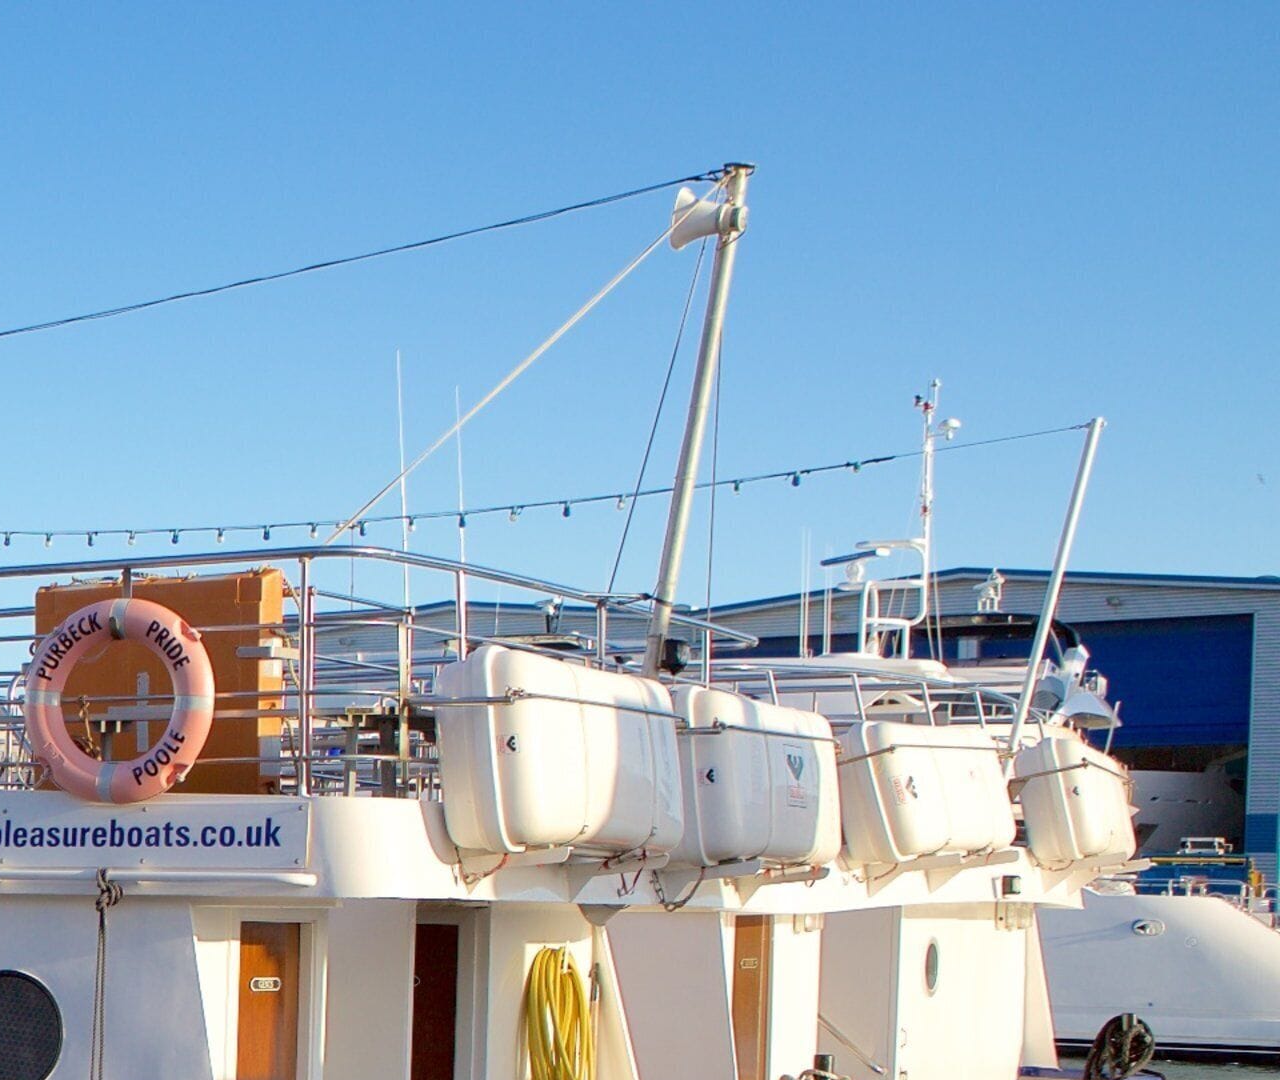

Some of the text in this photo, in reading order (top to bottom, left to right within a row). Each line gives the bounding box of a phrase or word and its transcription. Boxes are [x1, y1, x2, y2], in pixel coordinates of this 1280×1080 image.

[37, 611, 191, 682] PURBECK PRIDE
[132, 728, 186, 786] POOLE
